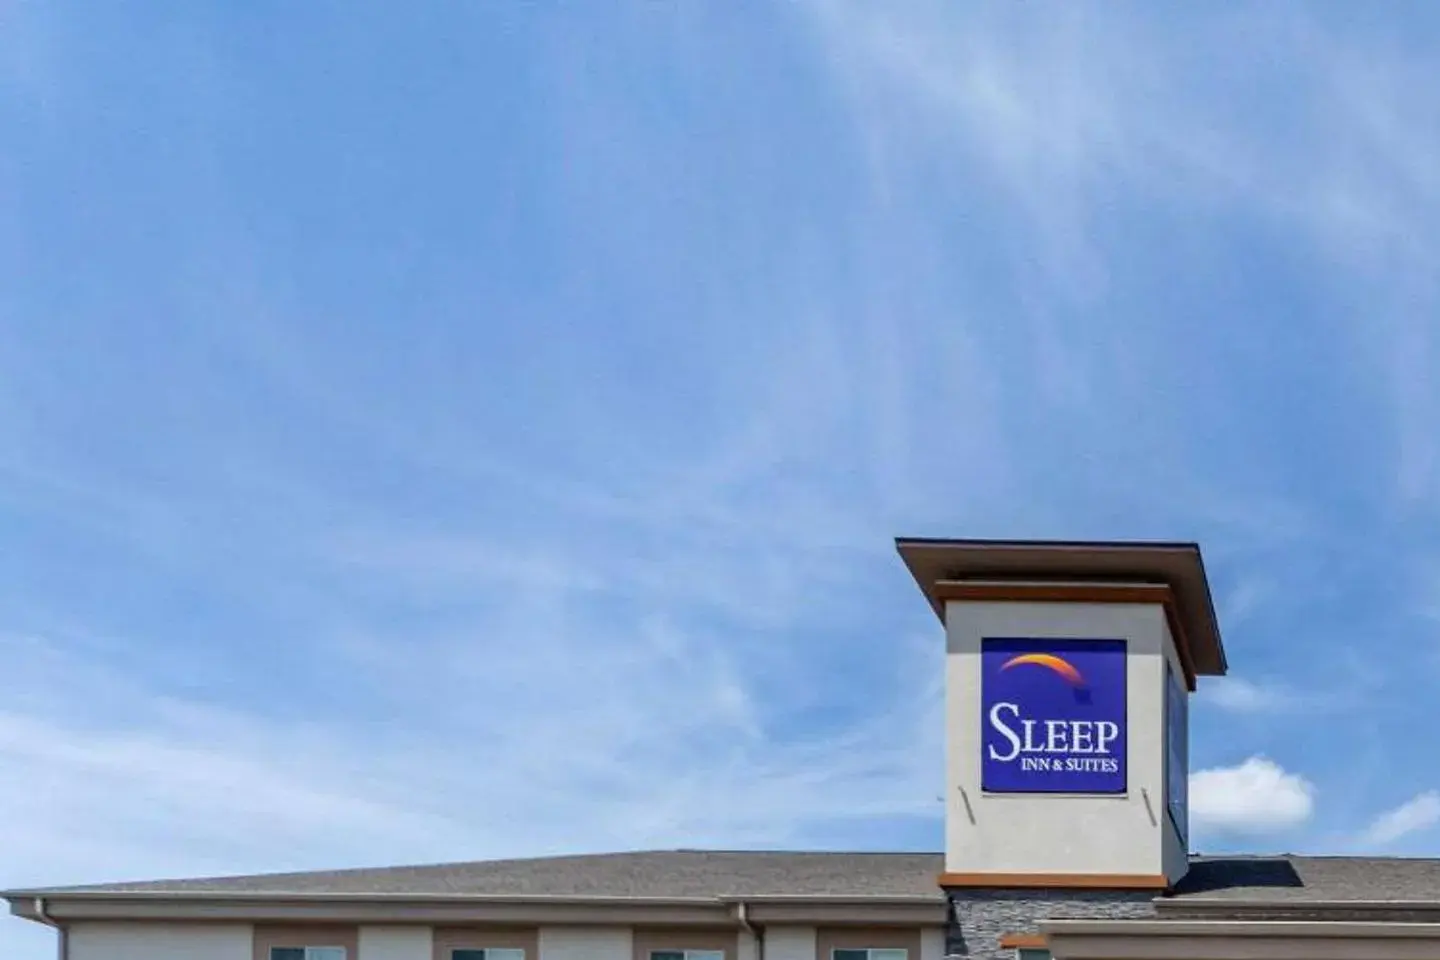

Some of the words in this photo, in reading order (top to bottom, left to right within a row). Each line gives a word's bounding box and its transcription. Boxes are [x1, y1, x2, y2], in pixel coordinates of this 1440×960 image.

[988, 702, 1119, 762] SLEEP
[1021, 757, 1050, 771] INN
[1052, 758, 1063, 772] &
[1065, 757, 1118, 773] SUITES
